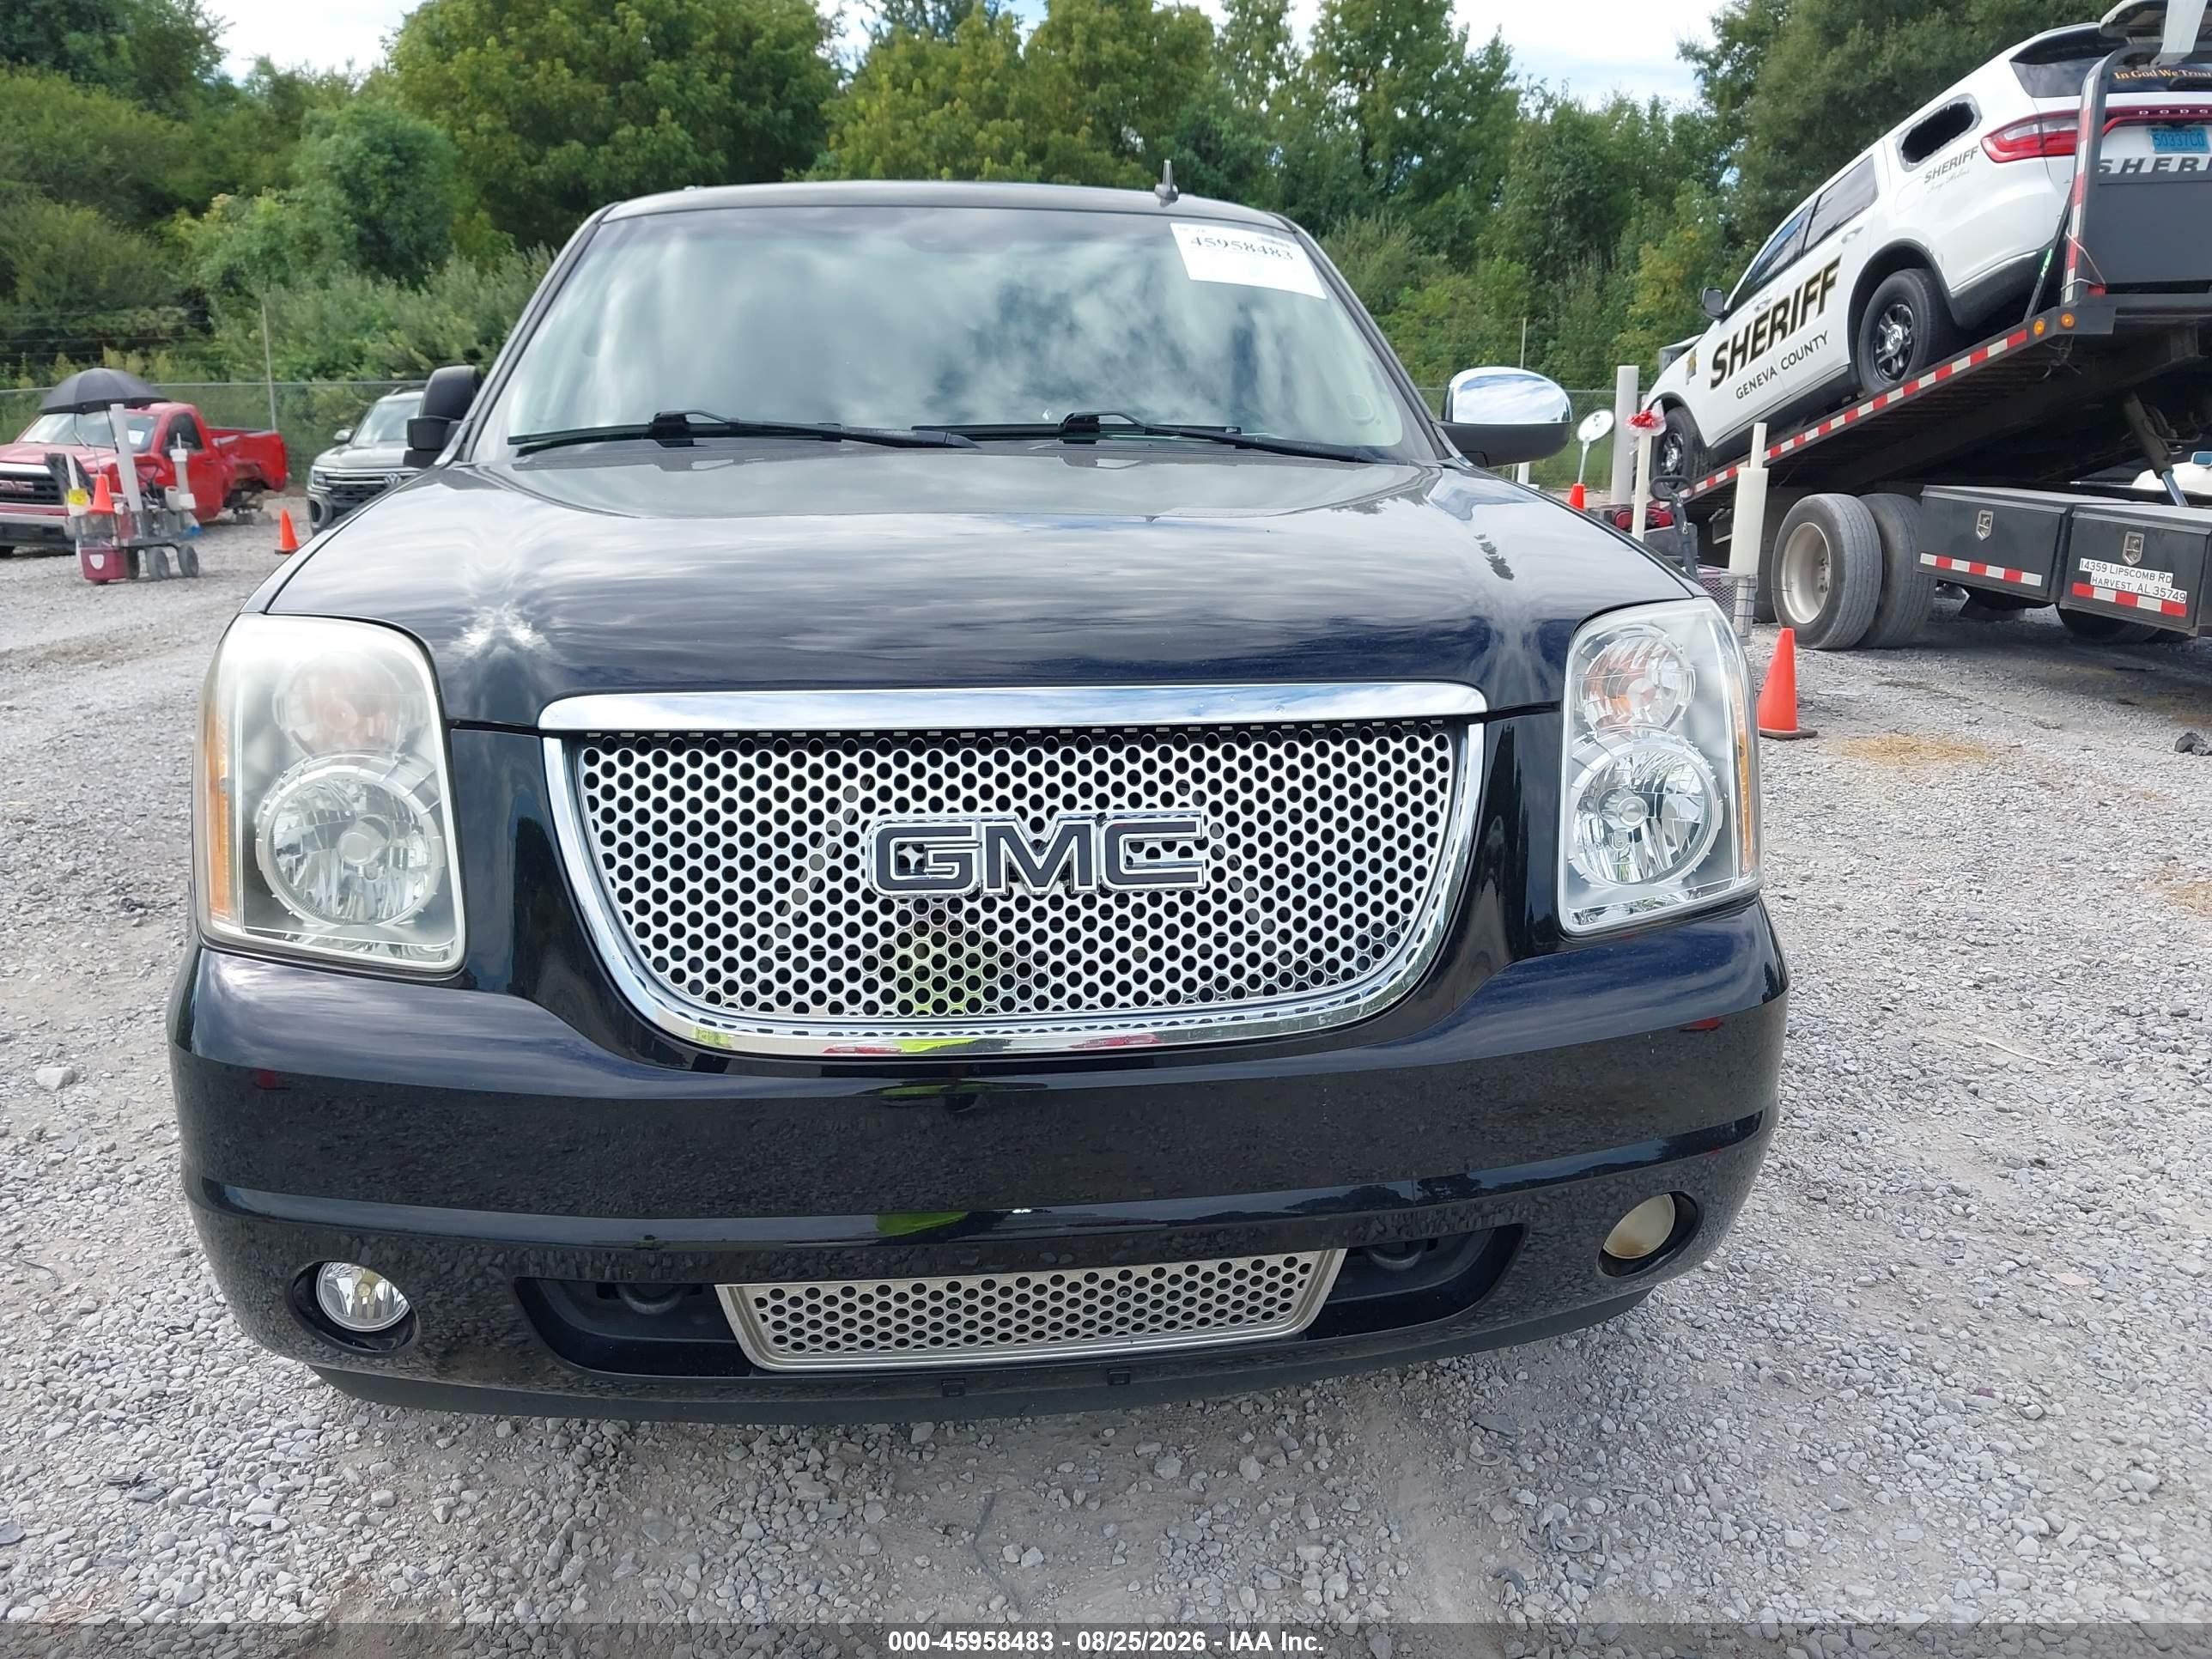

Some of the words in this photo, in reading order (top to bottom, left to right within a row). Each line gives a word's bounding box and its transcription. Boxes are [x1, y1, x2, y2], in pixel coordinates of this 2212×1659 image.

[2130, 70, 2157, 78] God
[2159, 69, 2179, 77] We
[1924, 145, 1979, 184] SHERIFF
[1710, 254, 1843, 390] SHERIFF
[1735, 366, 1778, 400] GENEVA
[1780, 331, 1828, 370] COUNTY
[2081, 560, 2107, 573] 14359
[2136, 583, 2150, 594] AL
[2153, 586, 2186, 601] 35749
[867, 811, 1206, 898] GMC
